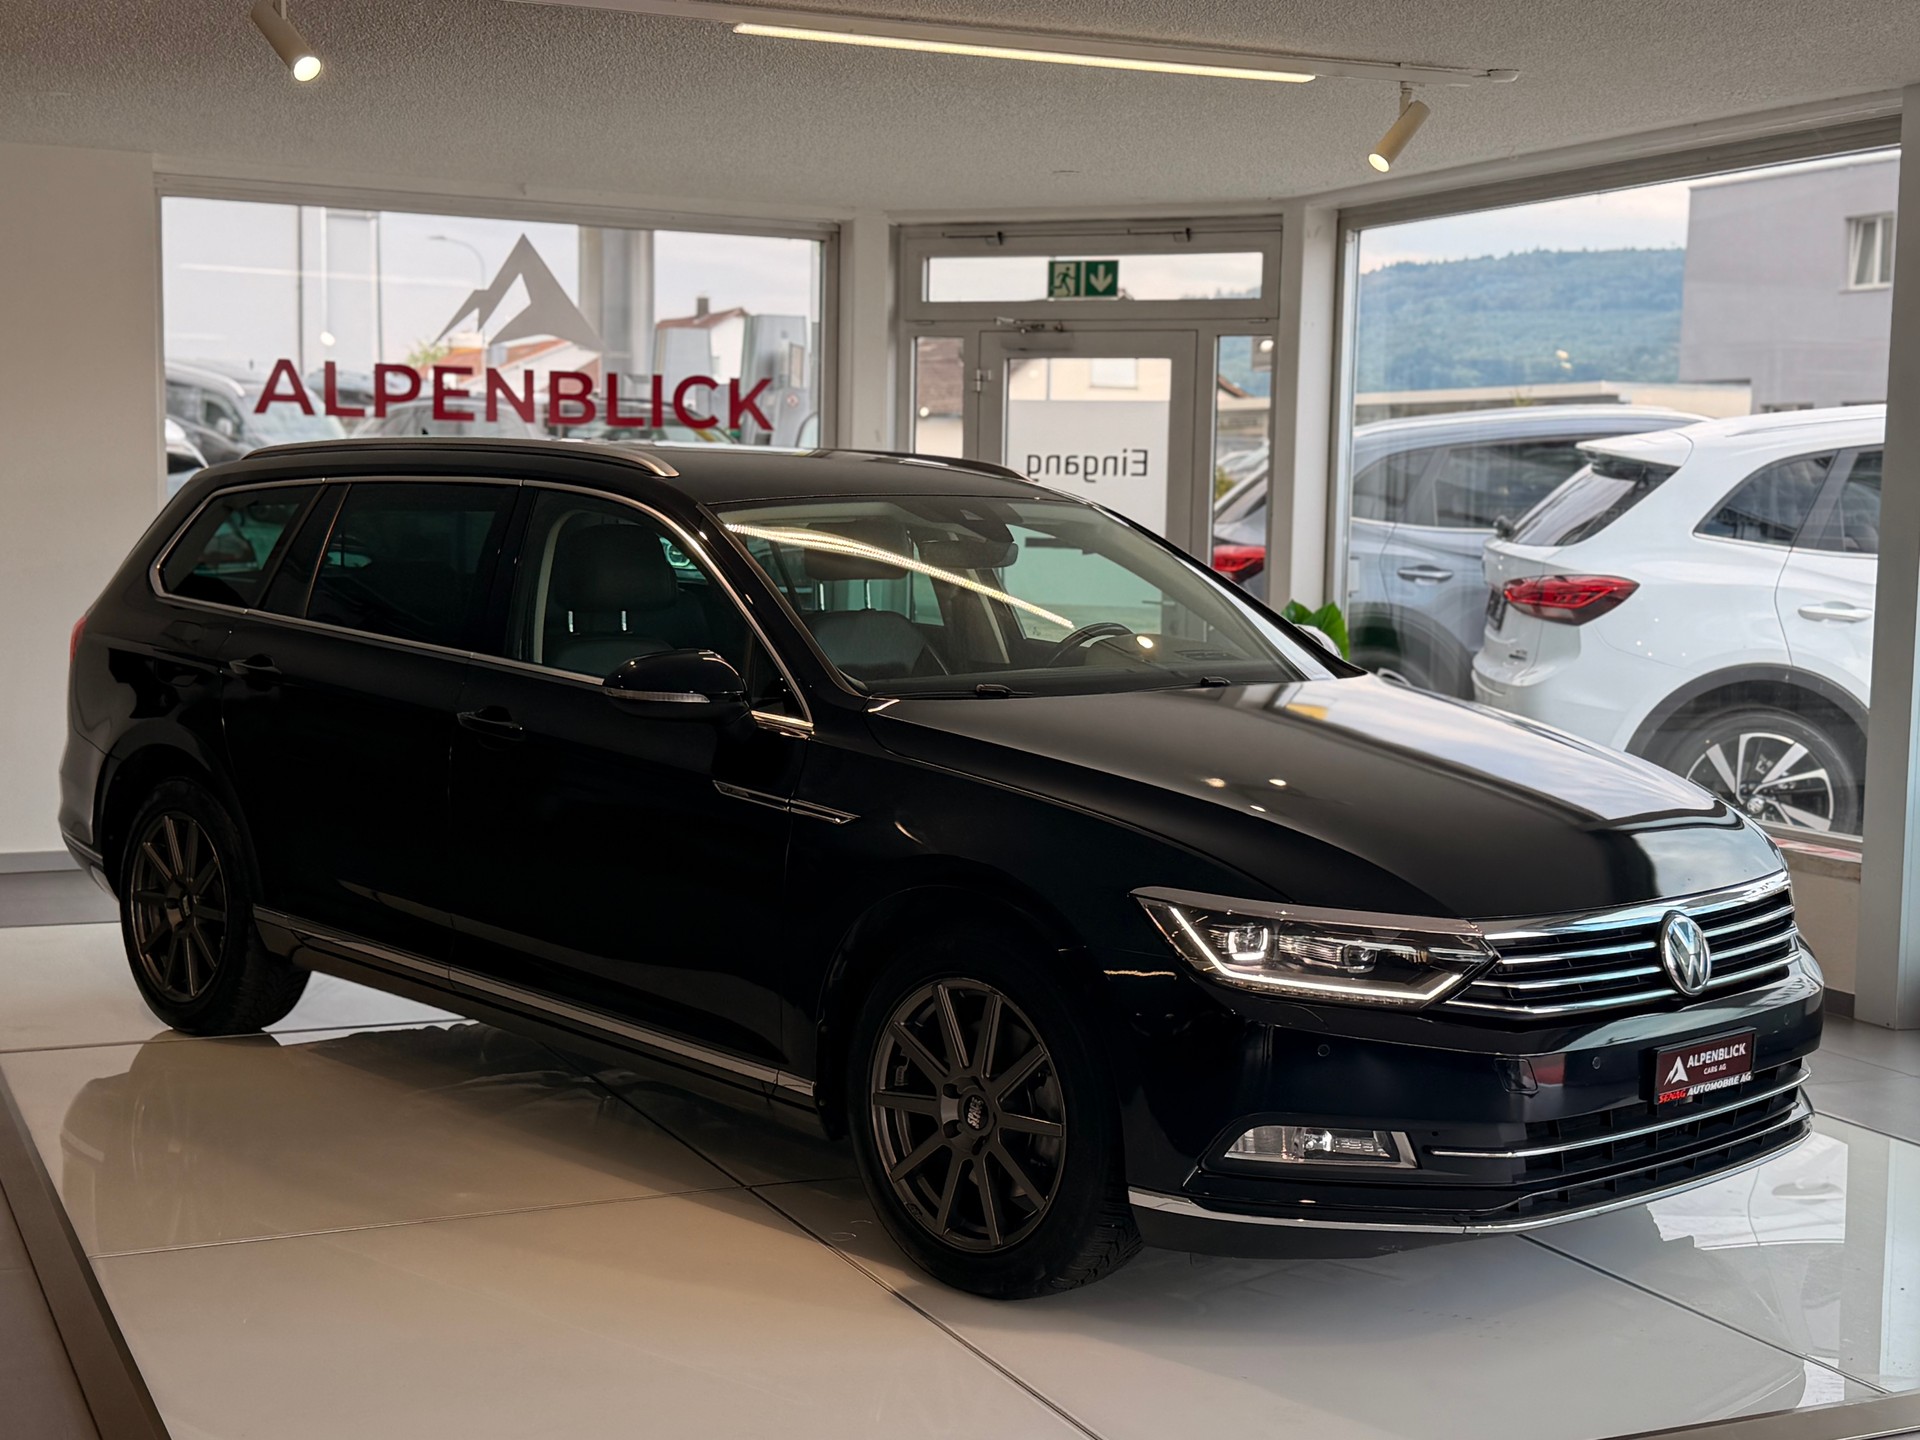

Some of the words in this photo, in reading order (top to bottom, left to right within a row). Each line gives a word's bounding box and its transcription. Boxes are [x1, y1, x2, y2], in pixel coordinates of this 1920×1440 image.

[253, 357, 775, 432] ALPENBLICK
[1687, 1042, 1746, 1068] ALPENBLICK
[1703, 1066, 1718, 1075] CARS
[1718, 1063, 1727, 1071] AG
[1687, 1075, 1740, 1096] AUTOMOBILE
[1739, 1072, 1752, 1084] AG
